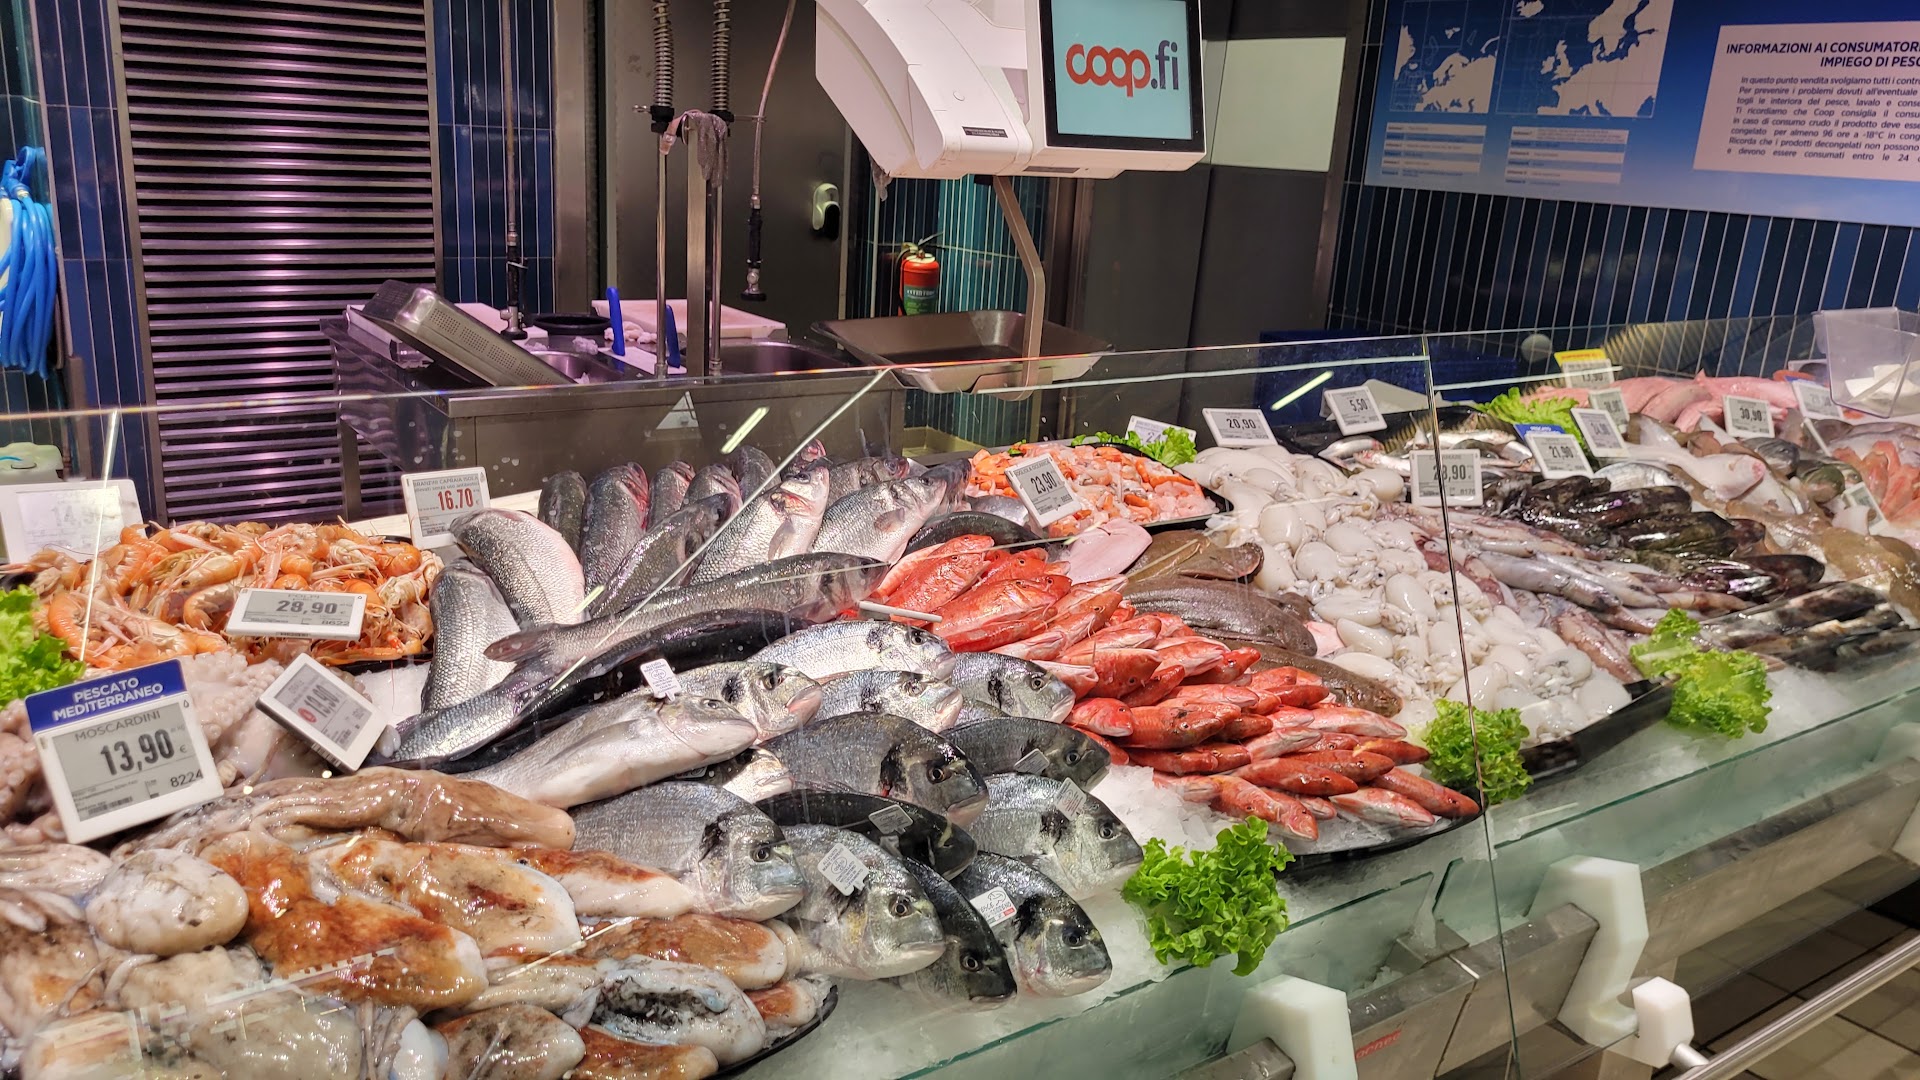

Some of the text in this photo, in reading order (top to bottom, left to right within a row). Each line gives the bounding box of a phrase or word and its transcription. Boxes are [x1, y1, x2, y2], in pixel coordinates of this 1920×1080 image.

[1726, 42, 1920, 54] INFORMAZIONI AI CONSUMATOR
[1065, 40, 1179, 98] coop.fi
[1820, 57, 1873, 68] IMPIEGO
[1875, 57, 1889, 67] DI
[1749, 77, 1775, 85] questo
[1776, 77, 1799, 85] punto
[1800, 77, 1829, 85] vendita
[1830, 77, 1872, 86] svolgiamo
[1873, 77, 1890, 85] tutti
[1739, 86, 1752, 94] Per
[1754, 87, 1789, 95] prevenire
[1798, 87, 1833, 96] problemi
[1837, 87, 1863, 95] dovuti
[1866, 88, 1918, 96] all'eventuale
[1737, 97, 1754, 105] togli
[1825, 99, 1850, 107] pesce,
[1814, 108, 1835, 117] Coop
[1841, 109, 1877, 118] consiglia
[1809, 119, 1831, 127] crudo
[1841, 120, 1878, 129] prodotto
[1880, 121, 1901, 129] deve
[1731, 128, 1767, 136] congelato
[1773, 129, 1787, 137] per
[1790, 129, 1819, 137] almeno
[1822, 129, 1833, 138] 96
[1887, 131, 1896, 139] in
[1729, 137, 1757, 145] Ricorda
[1759, 137, 1773, 145] che
[1780, 139, 1812, 147] prodotti
[1815, 140, 1862, 149] decongelati
[1883, 143, 1920, 151] possono
[1738, 147, 1766, 156] devono
[1804, 151, 1845, 159] consumati
[1852, 152, 1875, 160] entro
[1882, 152, 1890, 161] le
[1897, 154, 1909, 162] 24
[1349, 398, 1368, 412] 5,50
[1226, 418, 1257, 430] 20,90
[1548, 445, 1574, 460] 21,90
[1030, 471, 1058, 495] 23,90
[437, 487, 474, 512] 16.70
[276, 600, 338, 615] 28,90
[73, 677, 140, 704] PESCATO
[52, 683, 164, 722] MEDITERRANEO
[74, 710, 161, 742] MOSCARDINI
[100, 728, 175, 776] 13,90
[170, 768, 204, 788] 8224
